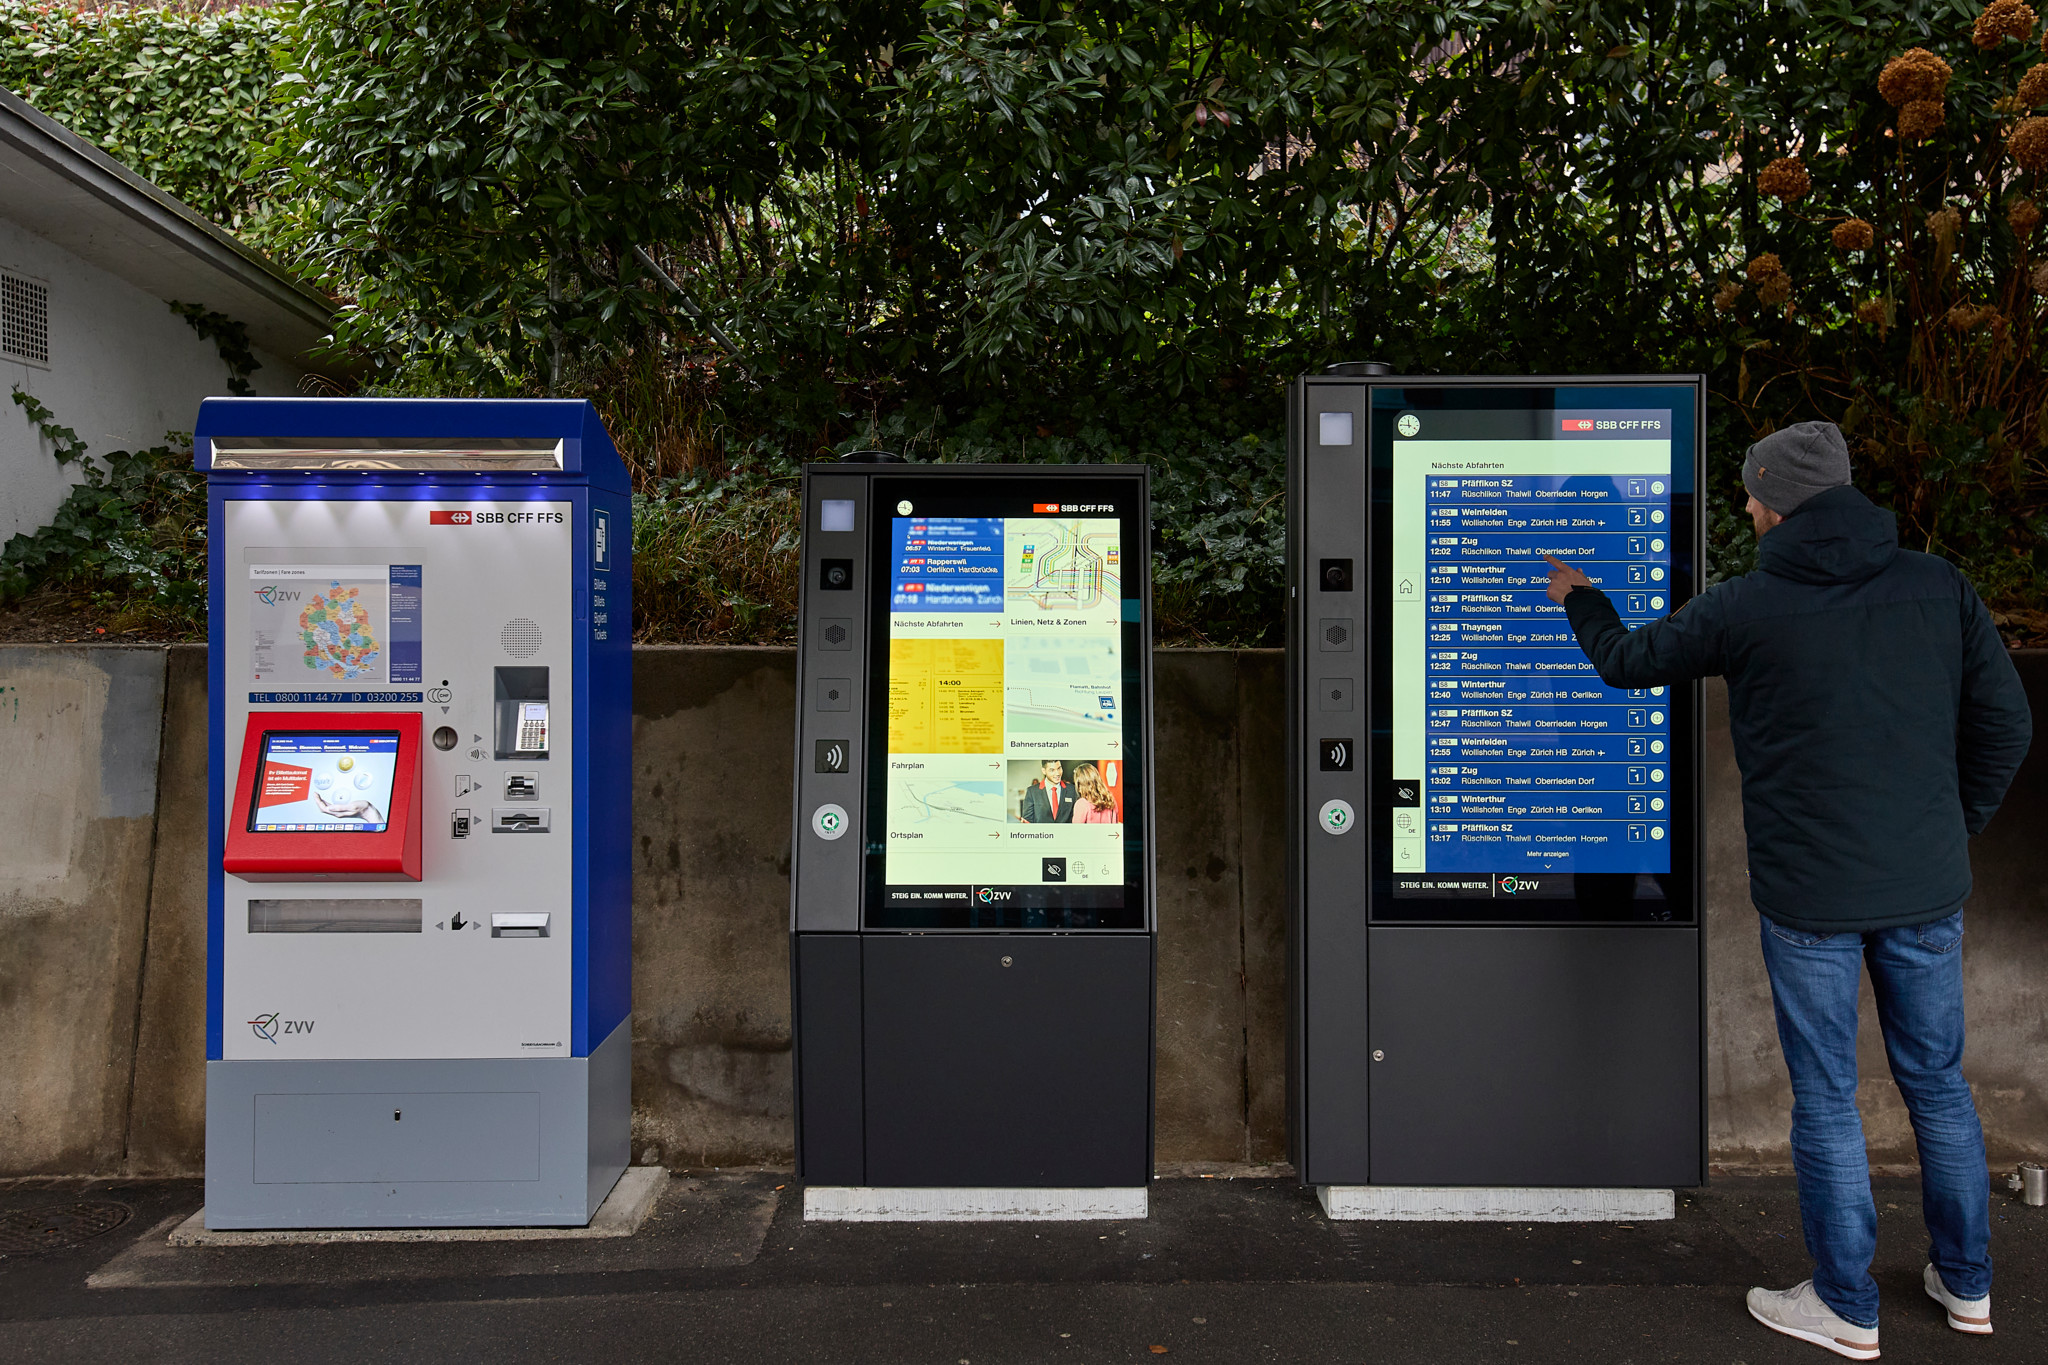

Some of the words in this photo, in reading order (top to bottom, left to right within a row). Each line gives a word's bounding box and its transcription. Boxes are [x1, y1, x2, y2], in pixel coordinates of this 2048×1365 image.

[1596, 420, 1617, 430] SBB
[1619, 420, 1639, 430] CFF
[1641, 420, 1661, 430] FFS
[1501, 479, 1513, 487] SZ
[1430, 490, 1451, 498] 11:47
[1462, 490, 1502, 498] Rüschlikon
[1506, 490, 1532, 498] Thalwil
[1535, 490, 1577, 498] Oberrieden
[1580, 490, 1608, 500] Horgen
[1061, 504, 1078, 512] SBB
[1080, 504, 1096, 512] CFF
[1098, 504, 1114, 512] FFS
[1461, 508, 1508, 516] Weinfelden
[476, 512, 504, 524] SBB
[507, 512, 534, 524] CFF
[538, 512, 564, 524] FFS
[1508, 519, 1527, 528] Enge
[1556, 518, 1568, 526] HB
[1572, 518, 1596, 526] Zürich
[1461, 537, 1478, 546] Zug
[1430, 576, 1451, 584] 12:10
[1461, 576, 1504, 584] Wollishofen
[1508, 576, 1527, 586] Enge
[1530, 576, 1551, 584] Züric
[278, 591, 301, 601] ZVV
[1461, 594, 1499, 602] Pfäffikon
[1501, 594, 1513, 602] SZ
[894, 620, 925, 628] Nächste
[926, 620, 964, 628] Abfahrten
[1010, 618, 1035, 626] Linien,
[1063, 618, 1087, 626] Zonen
[1461, 623, 1502, 632] Thayngen
[1507, 634, 1527, 643] Enge
[1461, 652, 1478, 661] Zug
[1430, 662, 1451, 670] 12:32
[1461, 662, 1502, 670] Rüschlikon
[1505, 662, 1531, 670] Thalwil
[1535, 662, 1576, 670] Oberrieden
[1461, 680, 1506, 688] Winterthur
[254, 693, 270, 702] TEL
[275, 693, 299, 702] 0800
[303, 693, 312, 702] 11
[315, 693, 328, 702] 44
[330, 693, 342, 702] 77
[351, 693, 362, 702] ID
[367, 693, 397, 702] 03200
[400, 693, 418, 702] 255
[1507, 691, 1527, 700] Enge
[1530, 691, 1554, 699] Zürich
[1571, 691, 1602, 699] Oerlikon
[1461, 709, 1499, 717] Pfäffikon
[1501, 709, 1513, 717] SZ
[1580, 720, 1608, 730] Horgen
[1010, 740, 1069, 749] Bahnersatzplan
[1461, 738, 1508, 746] Weinfelden
[1430, 748, 1451, 756] 12:55
[1461, 748, 1504, 756] Wollishofen
[1508, 748, 1527, 758] Enge
[1530, 748, 1554, 756] Zürich
[1556, 748, 1568, 756] HB
[1571, 748, 1595, 756] Zürich
[892, 762, 924, 770] Fahrplan
[1461, 766, 1478, 776] Zug
[1578, 777, 1595, 785] Dorf
[1461, 795, 1506, 803] Winterthur
[1461, 806, 1504, 814] Wollishofen
[1508, 806, 1527, 815] Enge
[1530, 806, 1554, 814] Zürich
[1556, 806, 1568, 814] HB
[1571, 806, 1602, 814] Oerlikon
[1461, 824, 1499, 832] Pfäffikon
[1501, 824, 1513, 832] SZ
[890, 832, 924, 840] Ortsplan
[1430, 834, 1451, 842] 13:17
[1461, 834, 1502, 842] Rüschlikon
[1505, 834, 1532, 842] Thalwil
[1535, 834, 1576, 842] Oberrieden
[1580, 835, 1608, 843] Horgen
[1518, 881, 1539, 890] ZVV
[994, 892, 1012, 900] ZVV
[284, 1020, 315, 1034] ZVV
